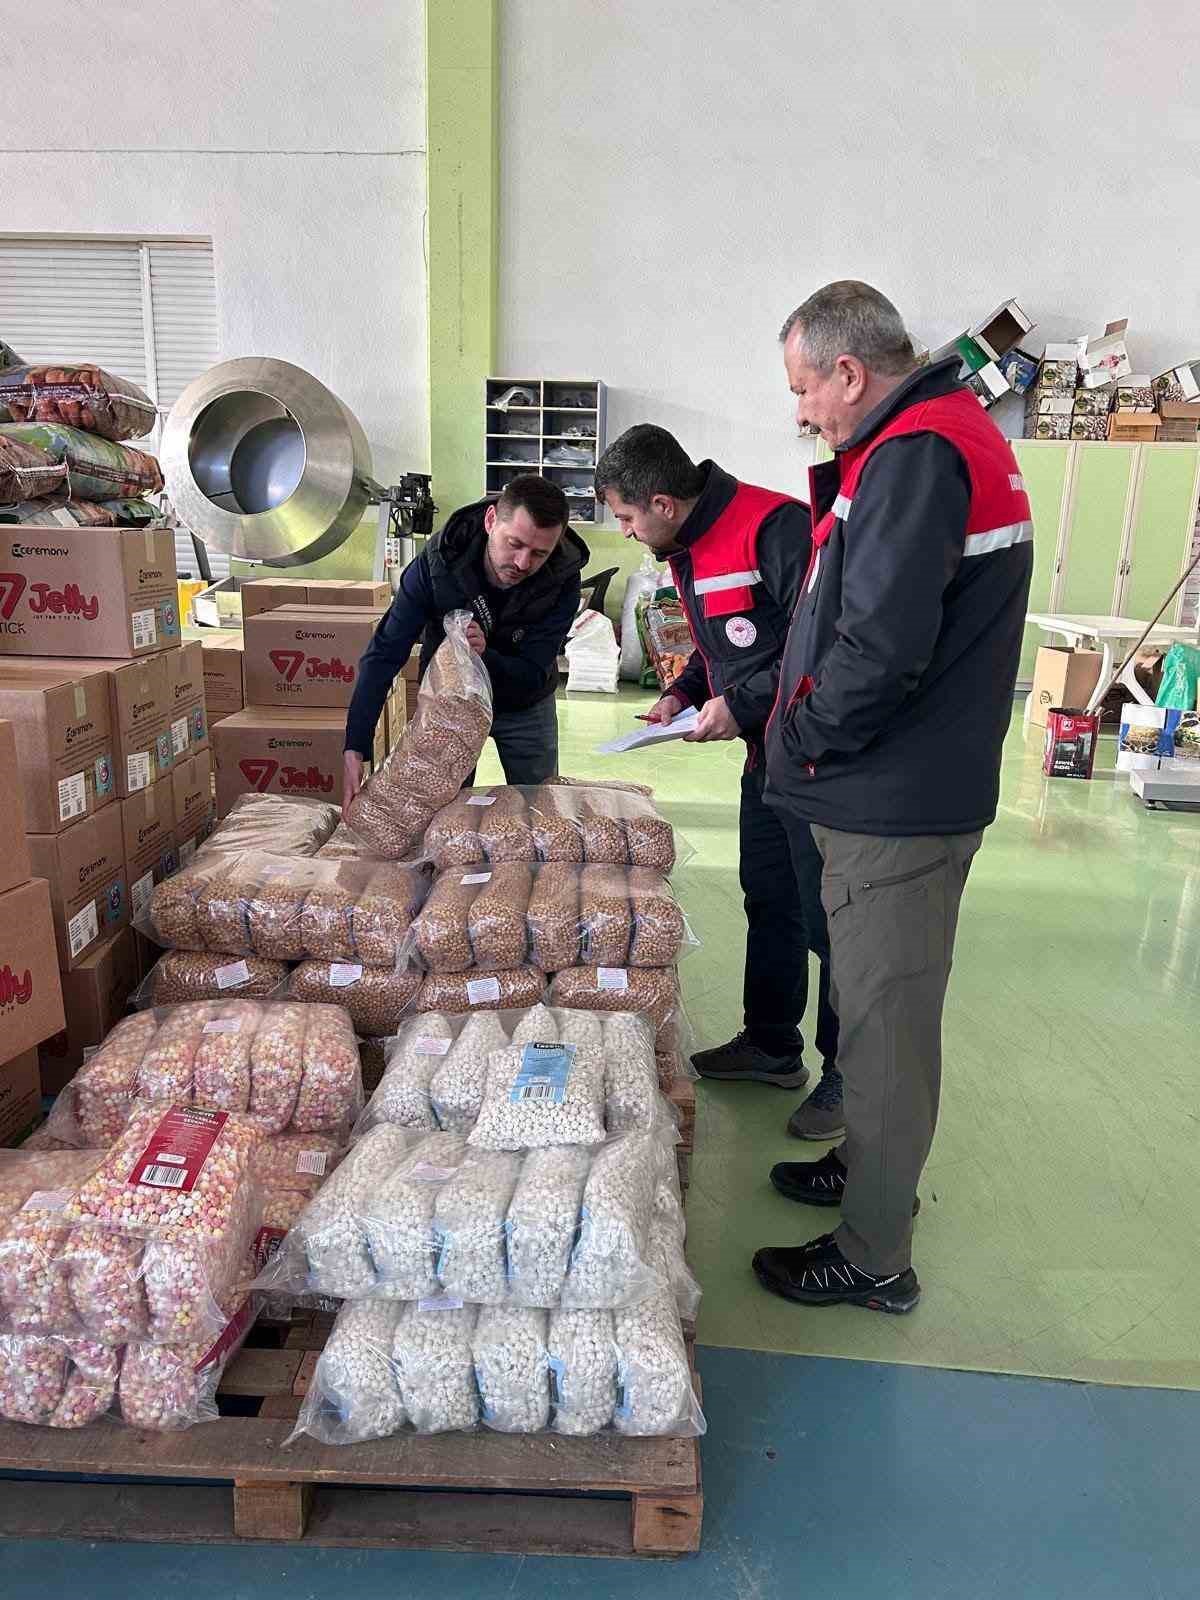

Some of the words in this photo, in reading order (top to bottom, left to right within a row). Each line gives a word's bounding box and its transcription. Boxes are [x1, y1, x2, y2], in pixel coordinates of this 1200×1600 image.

[29, 583, 99, 620] Jelly
[0, 622, 26, 634] TICK
[305, 657, 355, 683] Jelly
[274, 683, 303, 693] STICK
[279, 766, 335, 793] Jelly
